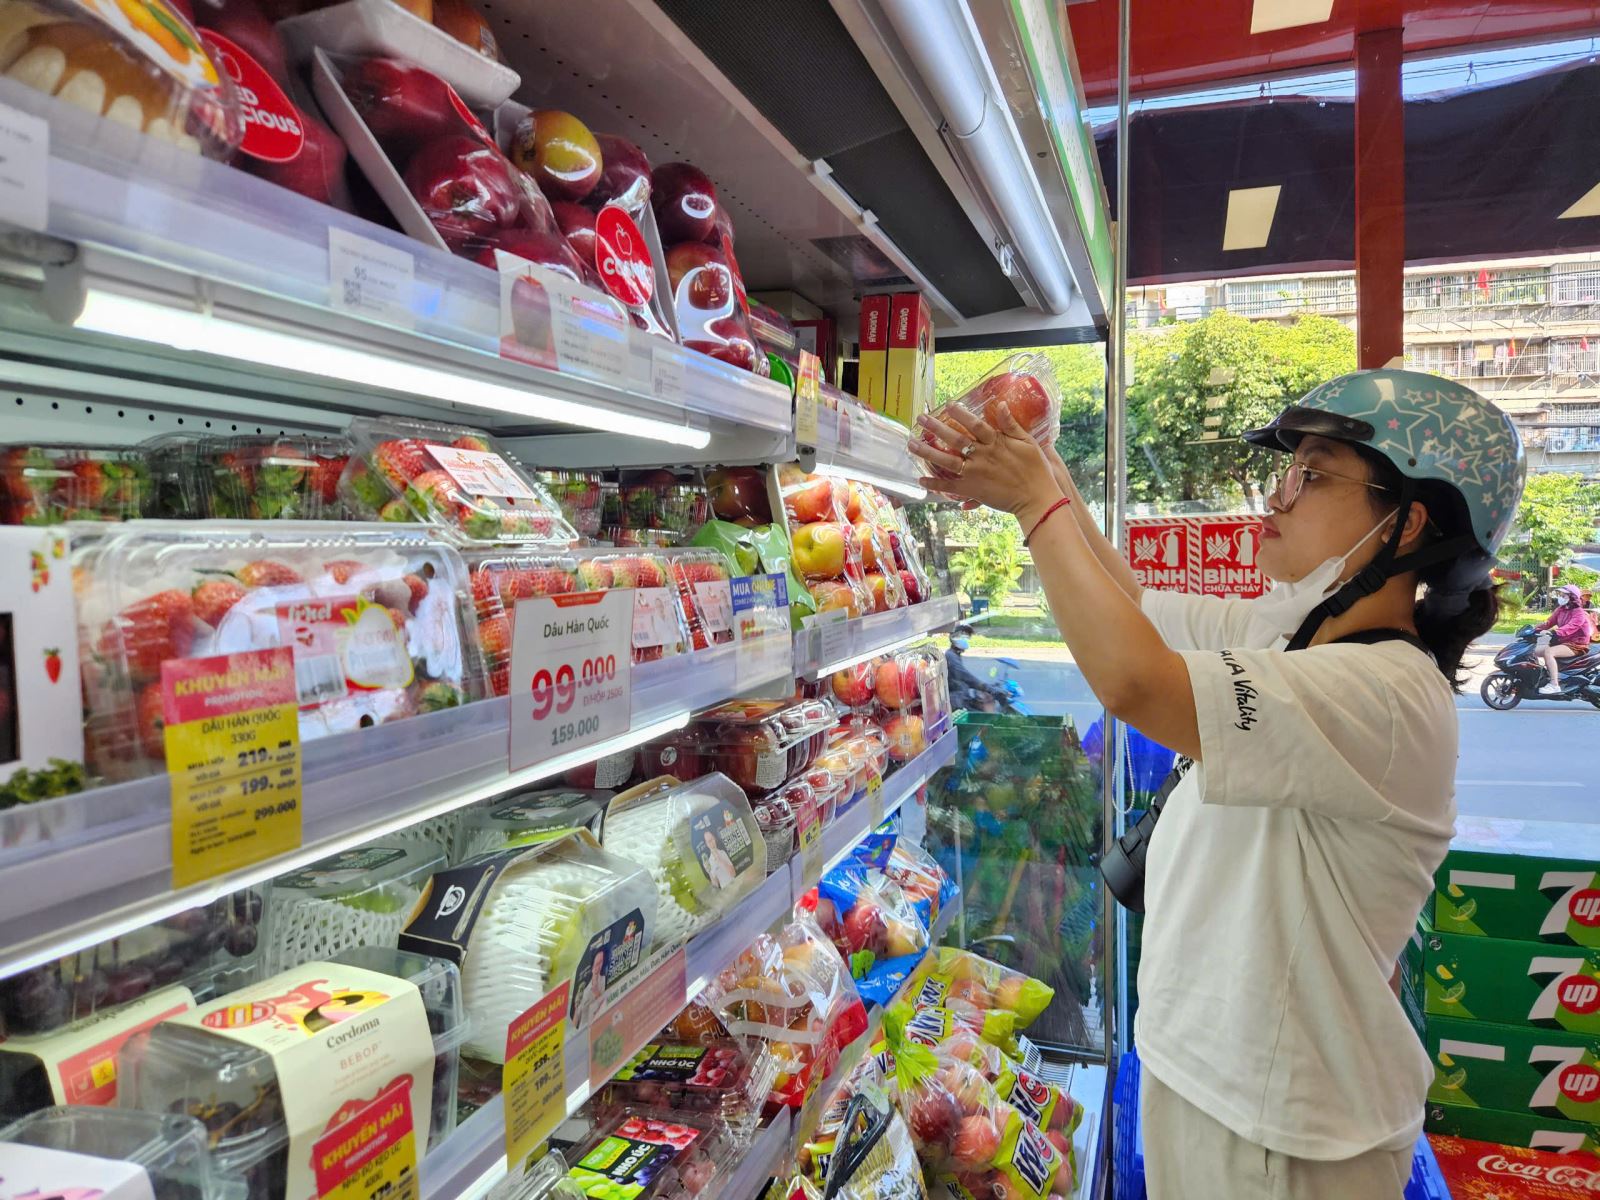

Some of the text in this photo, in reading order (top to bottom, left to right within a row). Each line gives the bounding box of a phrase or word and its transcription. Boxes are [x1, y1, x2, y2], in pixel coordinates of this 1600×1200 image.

[1135, 565, 1186, 584] BÌNH
[1204, 564, 1261, 584] BÌNH
[732, 582, 750, 597] MUA
[1204, 583, 1260, 593] CHỮA CHÁY
[544, 613, 610, 638] Dâu Hàn Quốc
[1233, 680, 1259, 731] Vitality
[202, 709, 281, 734] DÂU HÀN QUỐC
[551, 715, 600, 746] 159.000
[231, 730, 256, 745] 330G
[340, 1044, 380, 1070] BEBOP
[321, 1102, 404, 1170] KHUYẾN MÃI
